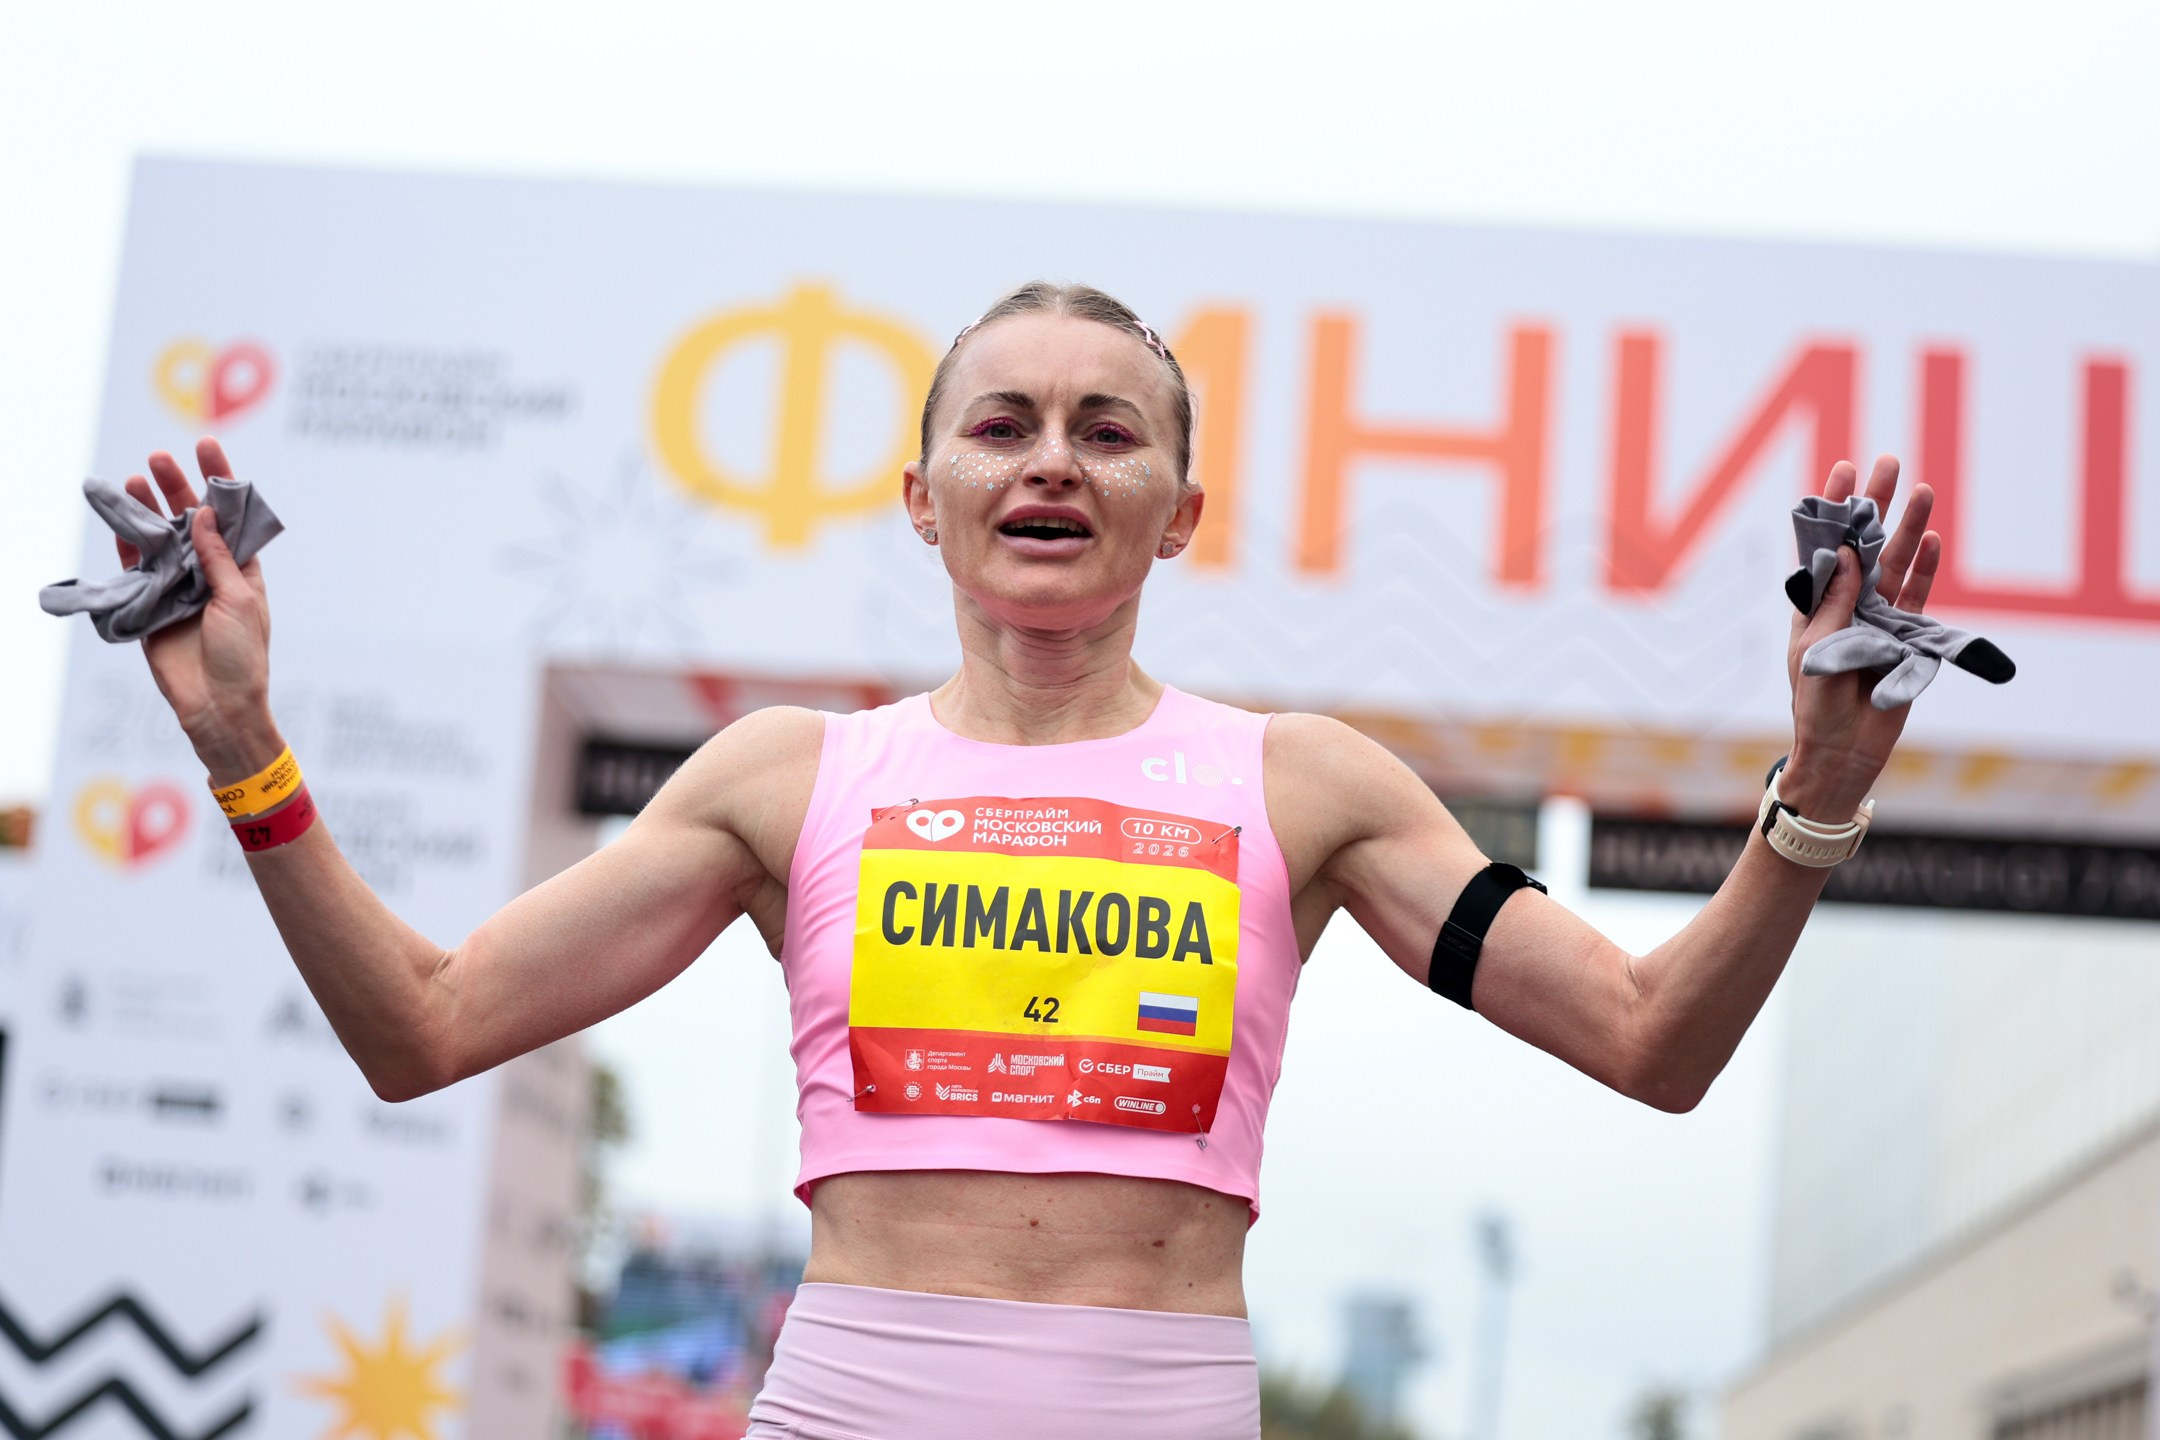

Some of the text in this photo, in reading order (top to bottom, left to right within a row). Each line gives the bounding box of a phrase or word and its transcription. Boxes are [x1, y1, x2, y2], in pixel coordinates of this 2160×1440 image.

[975, 807, 1069, 819] СБЕРПРАЙМ
[973, 818, 1102, 834] МОСКОВСКИЙ
[1133, 822, 1154, 835] 10
[246, 826, 271, 845] 42
[972, 832, 1067, 846] МАРАФОН
[1132, 842, 1190, 858] 2026
[881, 880, 1214, 965] СИМАКОВА
[1023, 996, 1060, 1023] 42
[927, 1050, 967, 1058] Департамент
[1010, 1053, 1065, 1066] МОСКОВСКИЙ
[1009, 1065, 1036, 1076] СПОРТ
[1097, 1062, 1164, 1078] СБЕР Прайм
[950, 1092, 978, 1102] BRICS
[1003, 1093, 1055, 1104] магнит
[1083, 1095, 1101, 1104] сбп
[1118, 1099, 1155, 1111] WINLINE
